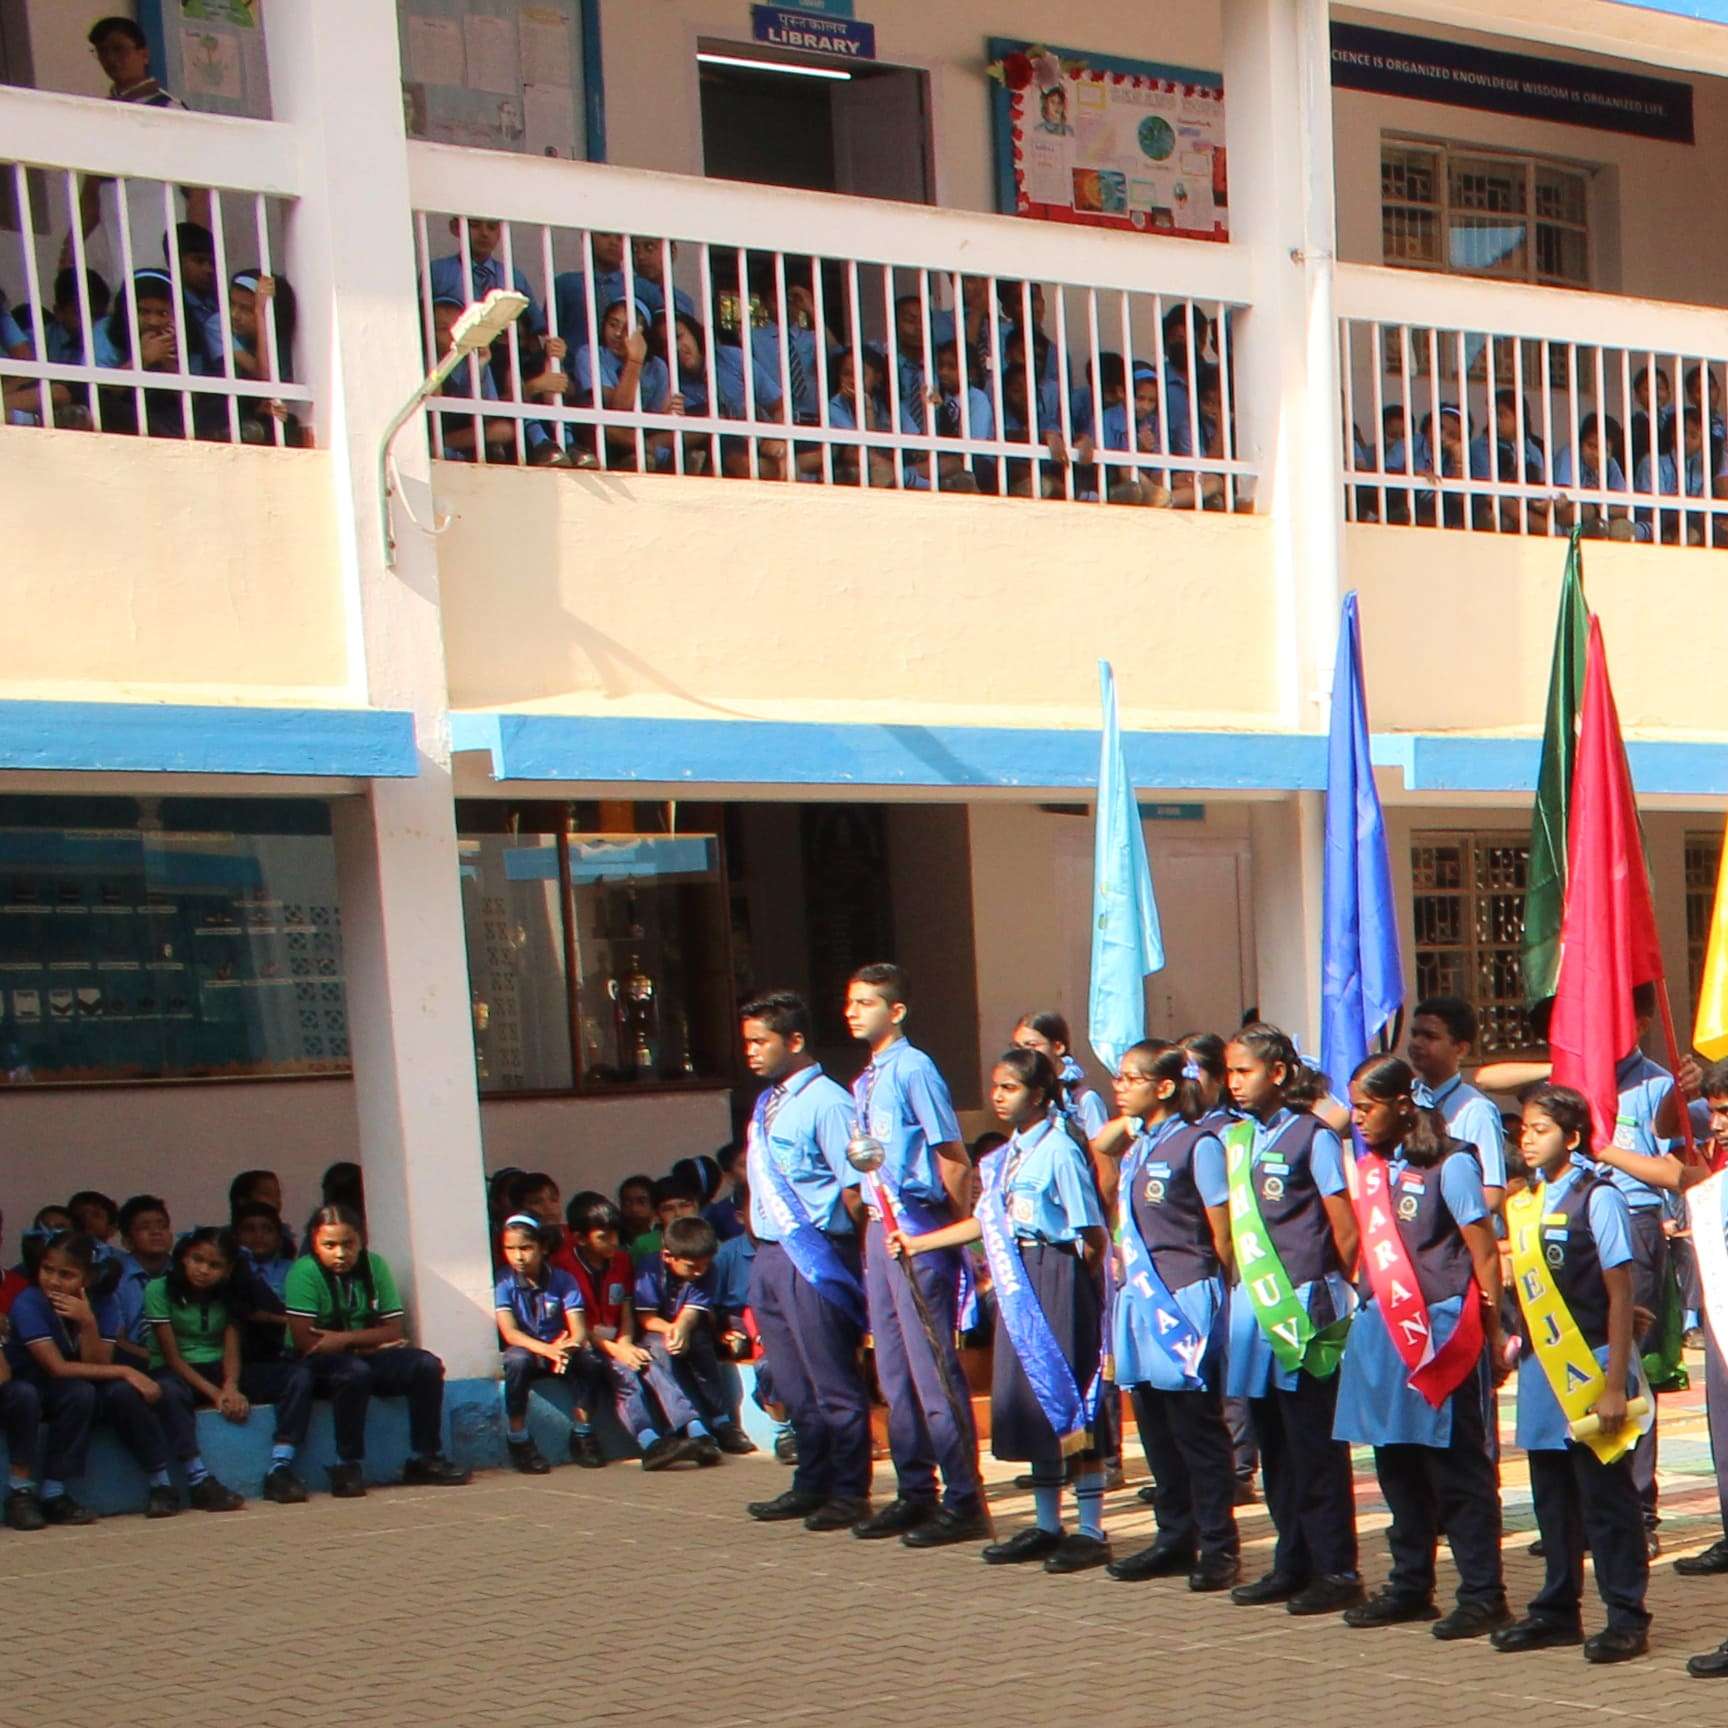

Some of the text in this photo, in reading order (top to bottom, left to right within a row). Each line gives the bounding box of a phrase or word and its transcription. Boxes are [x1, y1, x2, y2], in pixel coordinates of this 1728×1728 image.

[768, 27, 861, 55] LIBRARY
[1373, 56, 1384, 69] IS
[1386, 58, 1450, 80] ORGANIZED
[1522, 82, 1569, 100] WISDOM
[1571, 91, 1581, 101] IS
[1583, 92, 1642, 113] ORGANIZED
[1229, 1143, 1300, 1349] DHRUV
[1365, 1168, 1428, 1346] SARAN
[1517, 1224, 1593, 1394] TEJA
